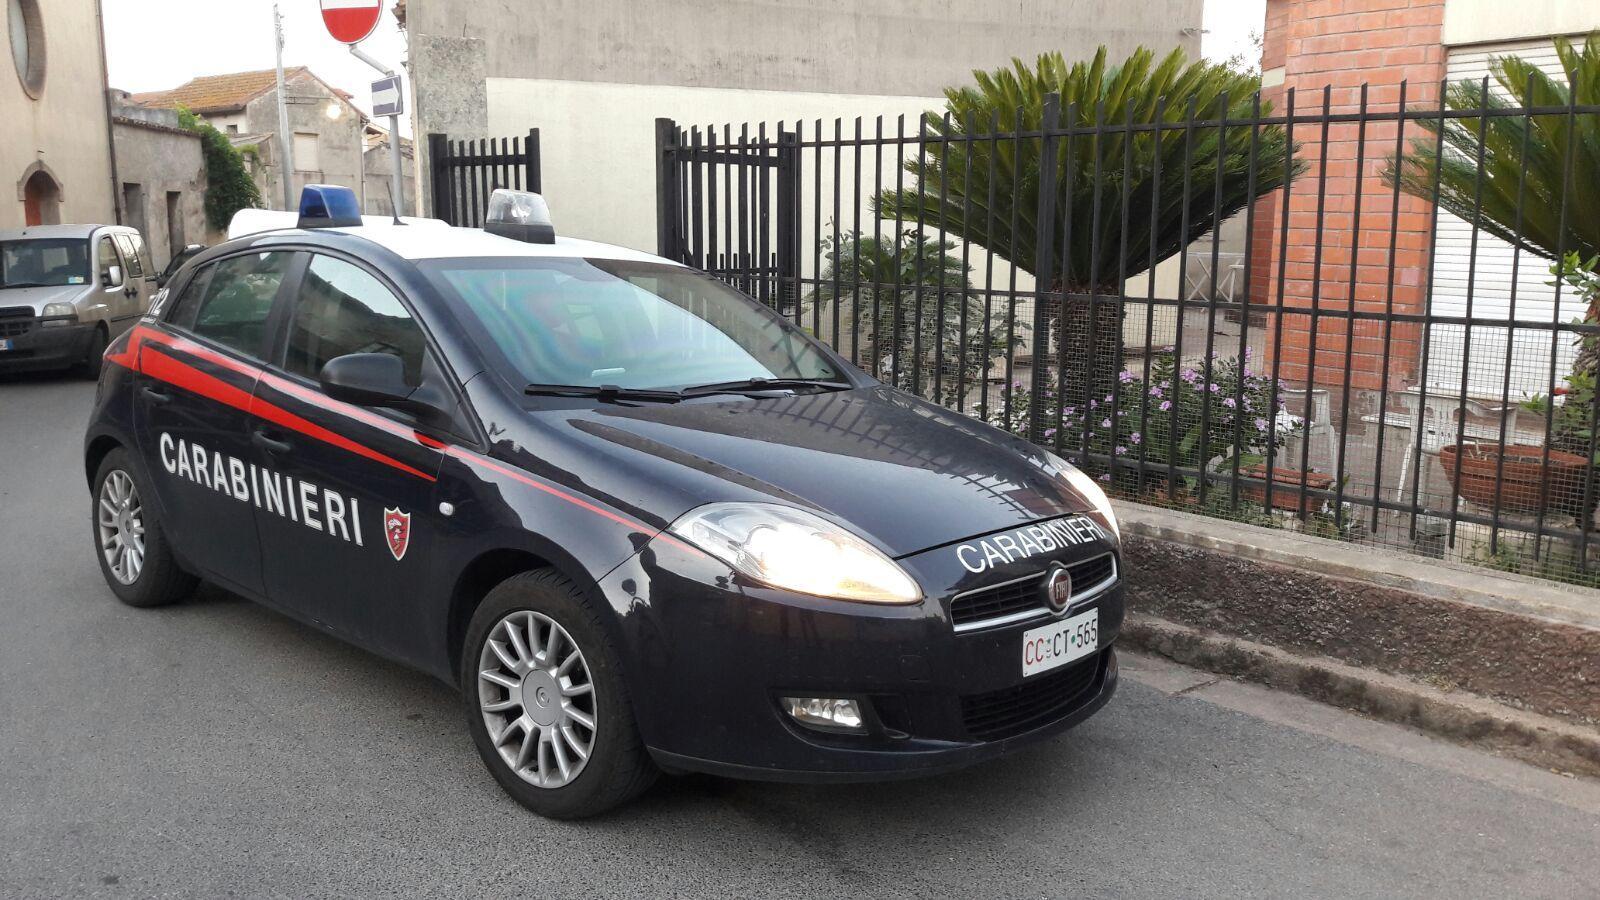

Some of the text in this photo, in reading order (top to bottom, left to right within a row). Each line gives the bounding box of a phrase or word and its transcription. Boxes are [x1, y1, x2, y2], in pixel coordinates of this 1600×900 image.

[160, 431, 363, 547] CARABINIERI
[956, 515, 1107, 574] CARABINIERI
[1055, 580, 1068, 600] FIAT
